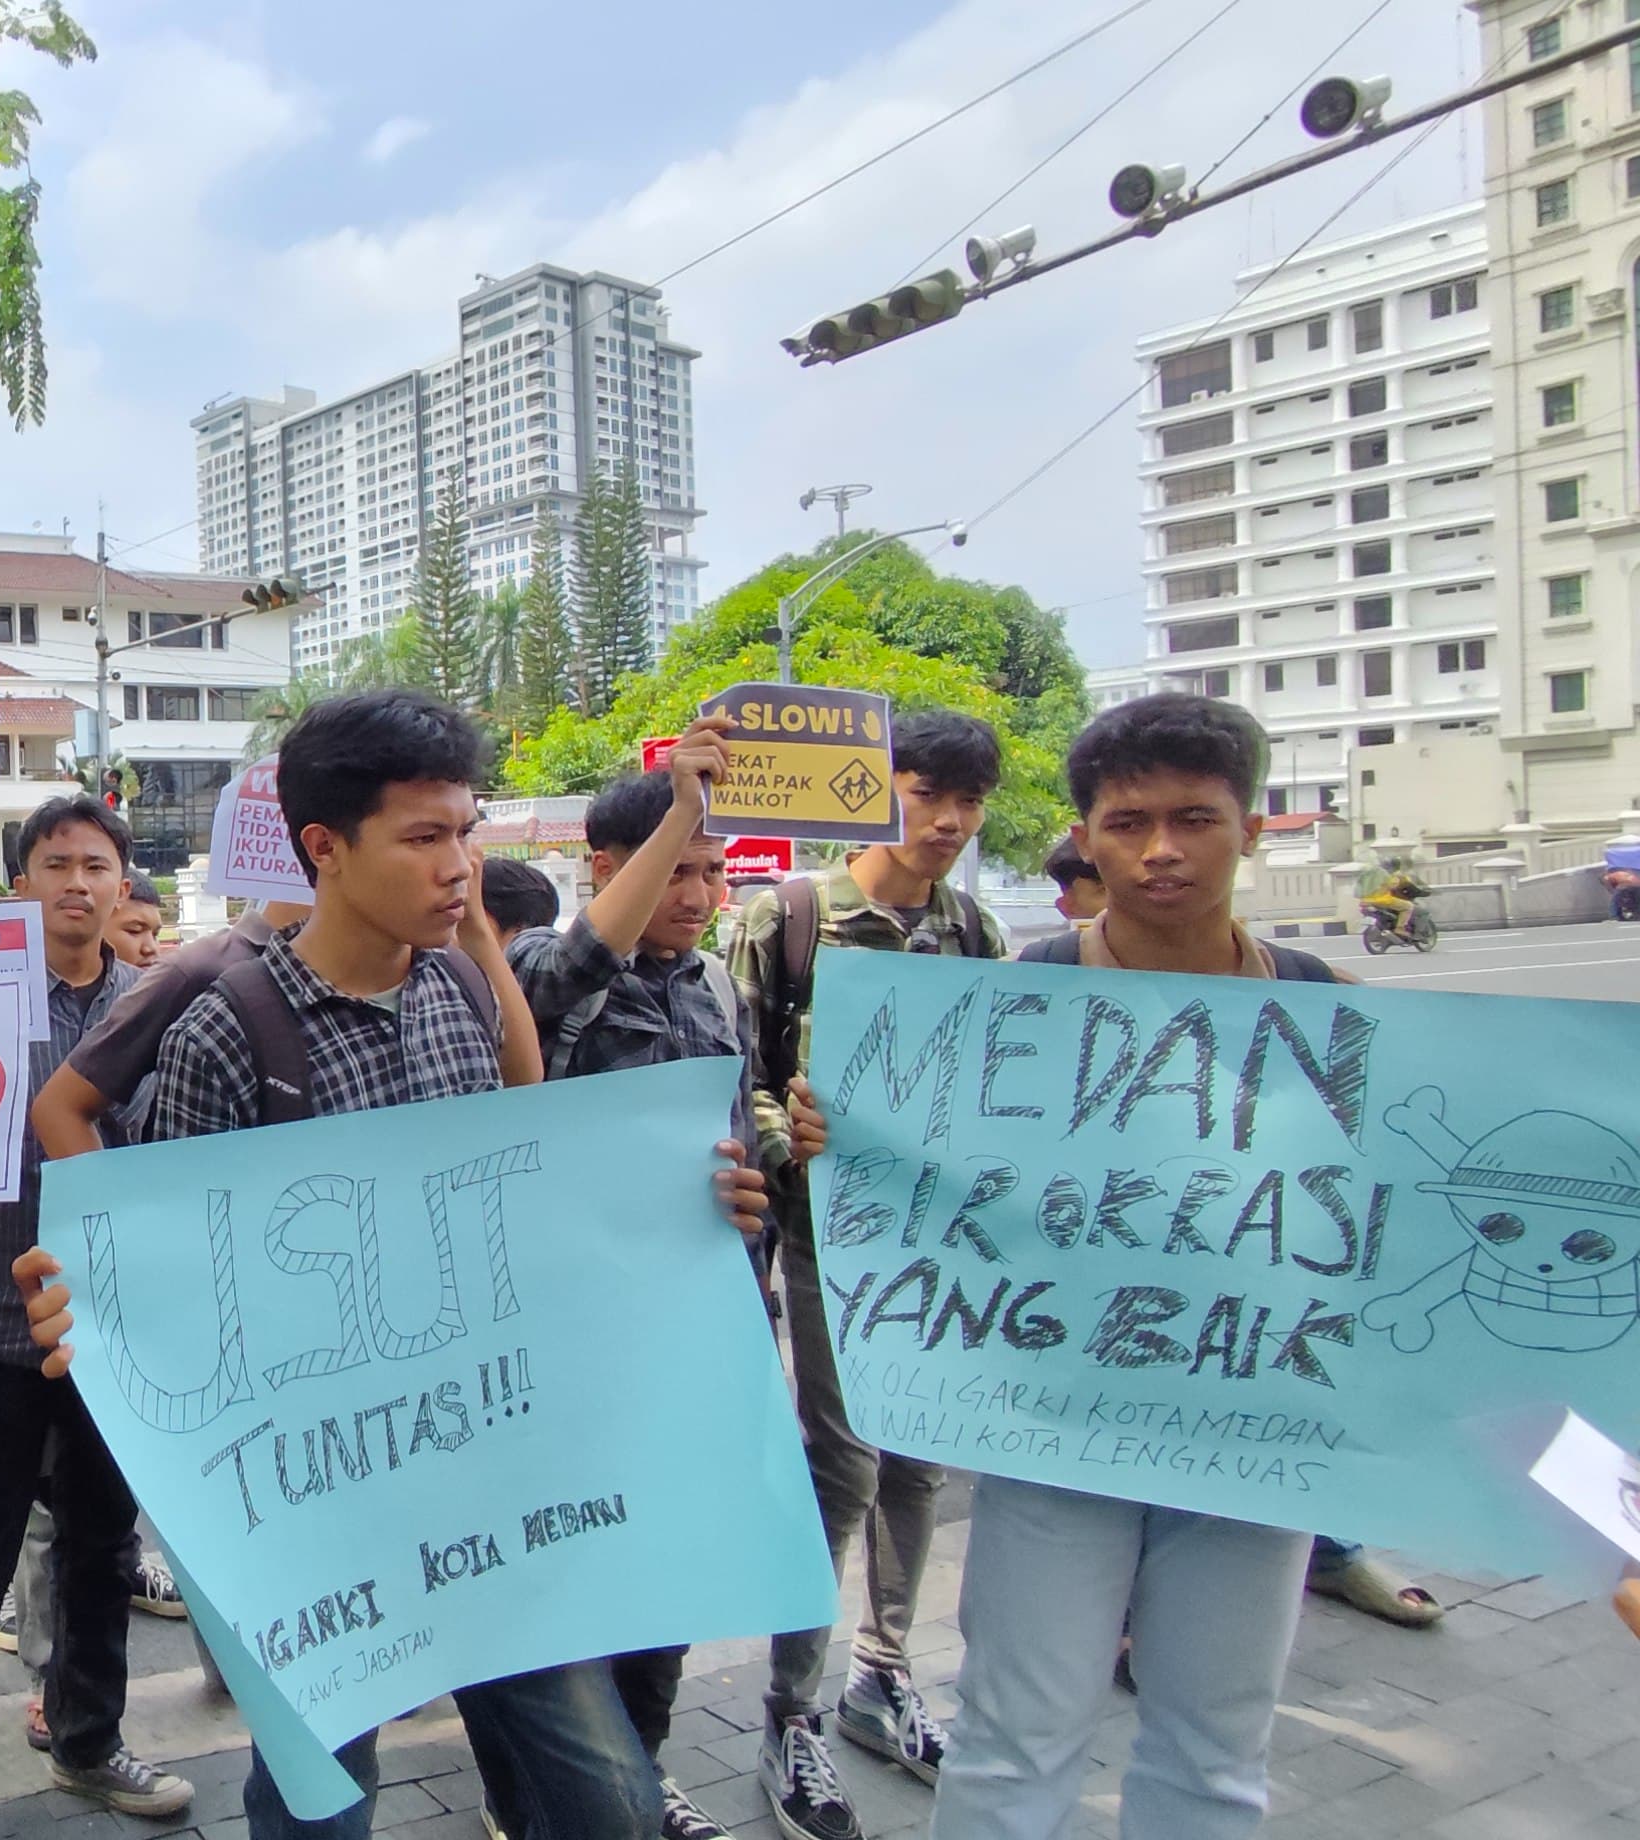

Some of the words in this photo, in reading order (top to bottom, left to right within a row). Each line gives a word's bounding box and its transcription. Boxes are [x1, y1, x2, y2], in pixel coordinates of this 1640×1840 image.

[741, 702, 854, 736] SLOW!
[727, 754, 777, 770] EKAT
[723, 773, 768, 789] AMA
[773, 775, 813, 791] PAK
[714, 790, 793, 808] WALKOT
[240, 804, 287, 823] PEM
[235, 837, 281, 855] IKUT
[233, 854, 307, 876] ATURA
[831, 976, 1380, 1155] MEDAN
[82, 1140, 542, 1432] USUT
[825, 1256, 1068, 1356] YANG
[1082, 1285, 1357, 1390] BAIK
[233, 1579, 386, 1675] IGARKI
[419, 1533, 507, 1594] KOTA
[522, 1494, 628, 1553] MEDAN
[353, 1626, 434, 1682] JABATAN
